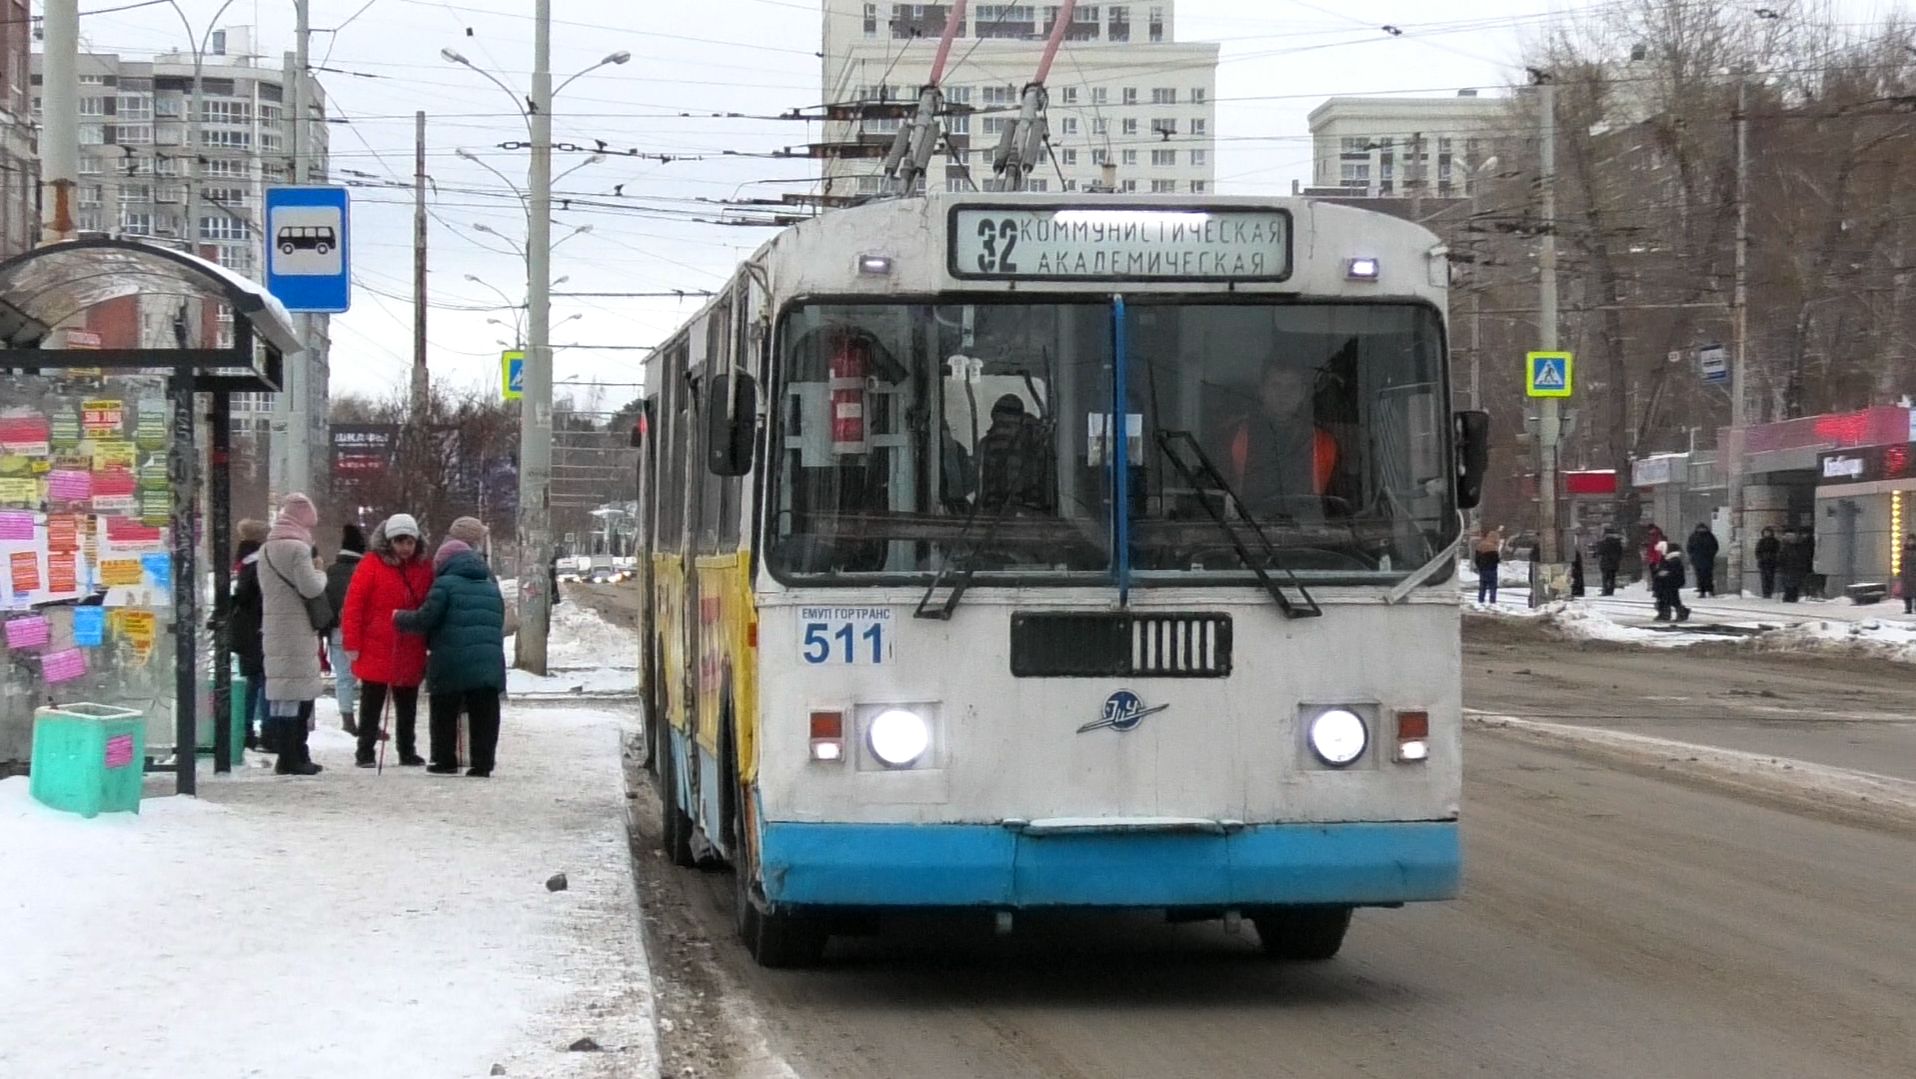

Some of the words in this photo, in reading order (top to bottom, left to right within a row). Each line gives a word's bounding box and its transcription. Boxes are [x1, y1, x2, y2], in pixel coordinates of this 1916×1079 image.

[1020, 219, 1282, 244] КОММУНИСТИЧЕСКАЯ
[977, 218, 1017, 273] 32
[1038, 250, 1265, 275] АКАДЕМИЧЕСКАЯ
[802, 608, 832, 619] ЕМУП
[835, 608, 890, 619] ГОРТРАНС
[803, 622, 882, 664] 511
